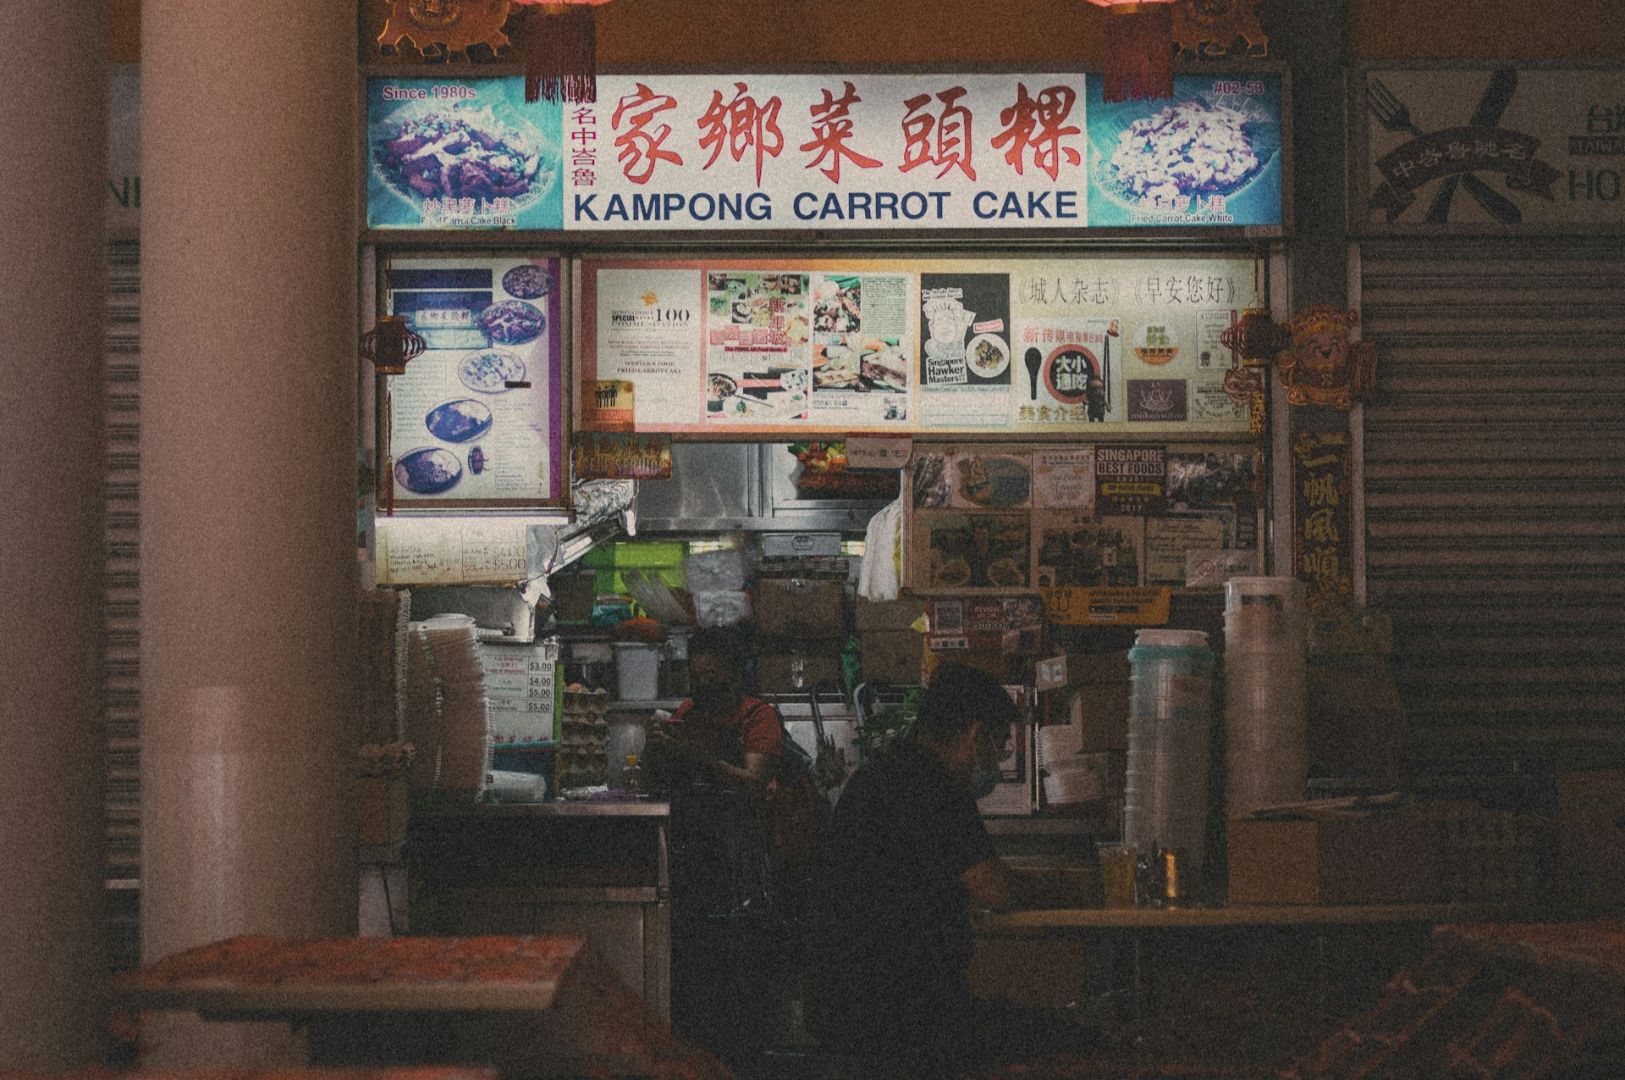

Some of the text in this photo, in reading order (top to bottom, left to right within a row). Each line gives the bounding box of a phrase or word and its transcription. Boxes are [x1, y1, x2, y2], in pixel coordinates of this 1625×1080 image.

[383, 86, 477, 100] Since 1980s
[611, 82, 1081, 188] 家鄉菜頭粿
[573, 190, 1079, 221] KAMPONG CARROT CAKE
[470, 216, 492, 225] Cake
[493, 216, 516, 225] Black
[1155, 213, 1183, 223] Carrot
[1184, 213, 1206, 223] Cake
[1208, 213, 1233, 223] White
[656, 308, 690, 322] 100
[928, 358, 964, 367] Singapore
[928, 366, 964, 375] Hawker
[929, 375, 959, 383] Masters
[1096, 449, 1164, 462] SINGAPORE
[1098, 463, 1163, 474] BEST FOODS
[529, 661, 552, 671] $3.00
[529, 677, 551, 686] $4.00
[529, 688, 551, 697] $5.00
[528, 702, 550, 711] $5.00
